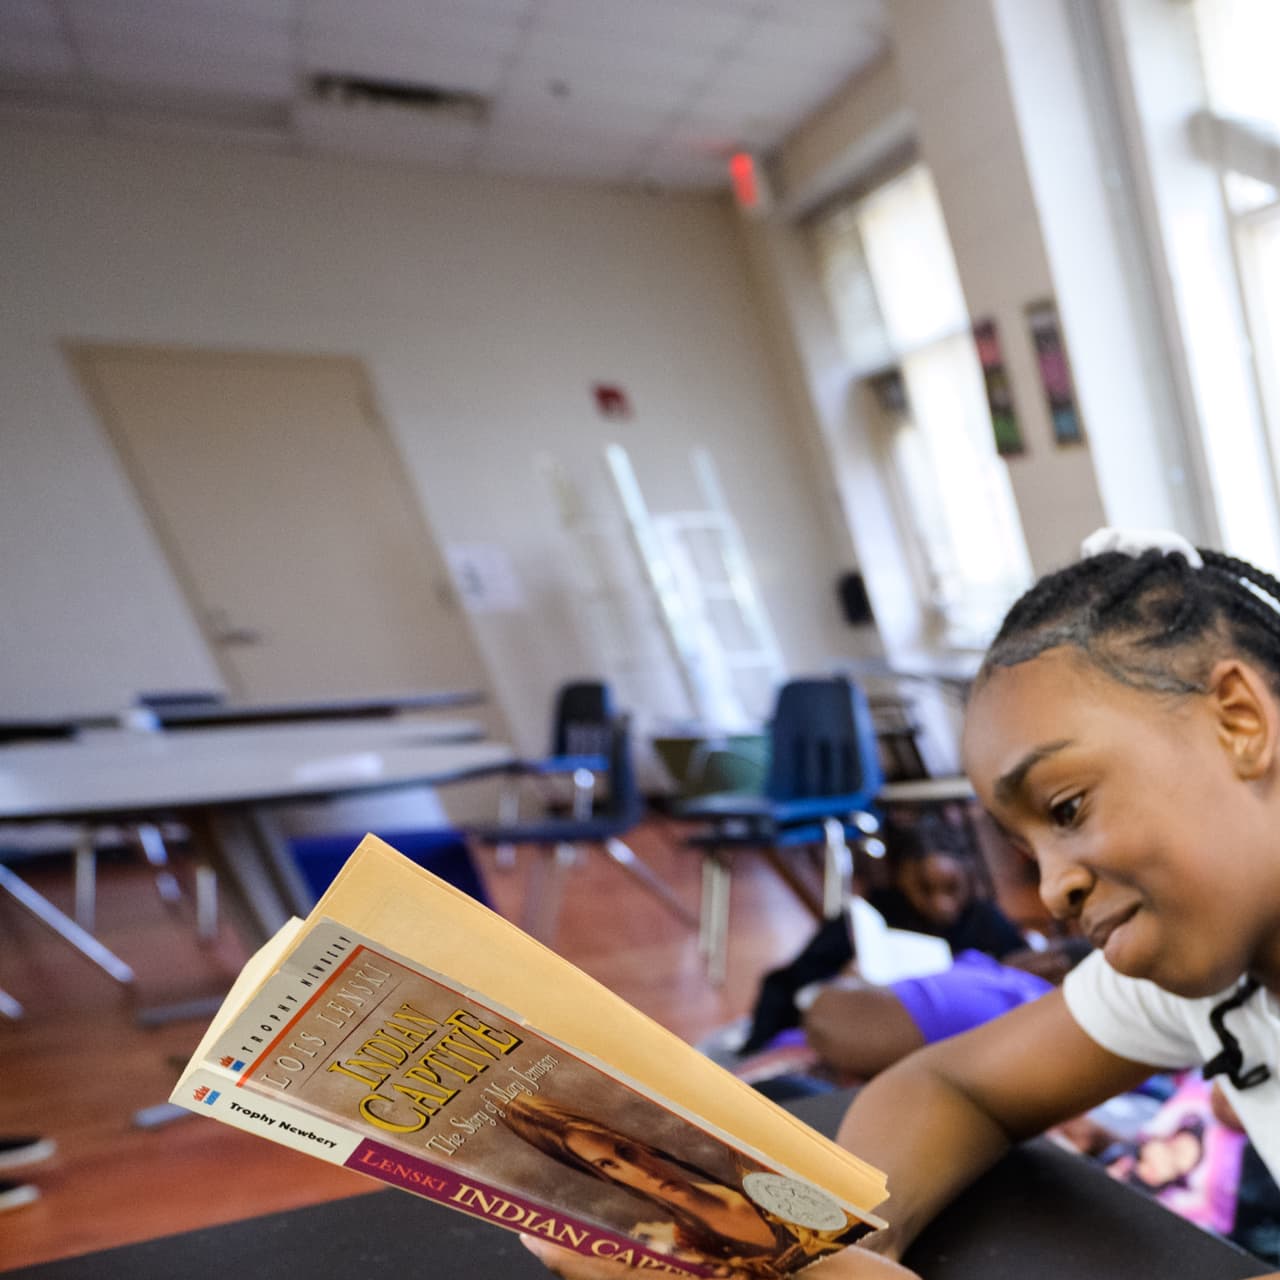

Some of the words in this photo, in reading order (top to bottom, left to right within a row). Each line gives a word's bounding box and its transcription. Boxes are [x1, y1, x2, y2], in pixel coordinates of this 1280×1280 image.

[241, 995, 298, 1053] TROPHY
[262, 1031, 327, 1090] LOIS
[317, 962, 392, 1029] LENSKI
[326, 1003, 445, 1091] INDIAN
[359, 1009, 524, 1133] CAPTIVE
[484, 1080, 533, 1104] Mary
[508, 1054, 560, 1091] Jemison
[229, 1101, 277, 1126] Trophy
[278, 1121, 338, 1149] Newbery
[449, 1110, 497, 1135] Story
[480, 1094, 506, 1118] of
[425, 1134, 465, 1156] The
[358, 1149, 448, 1193] LENSKI
[449, 1183, 590, 1248] INDIAN
